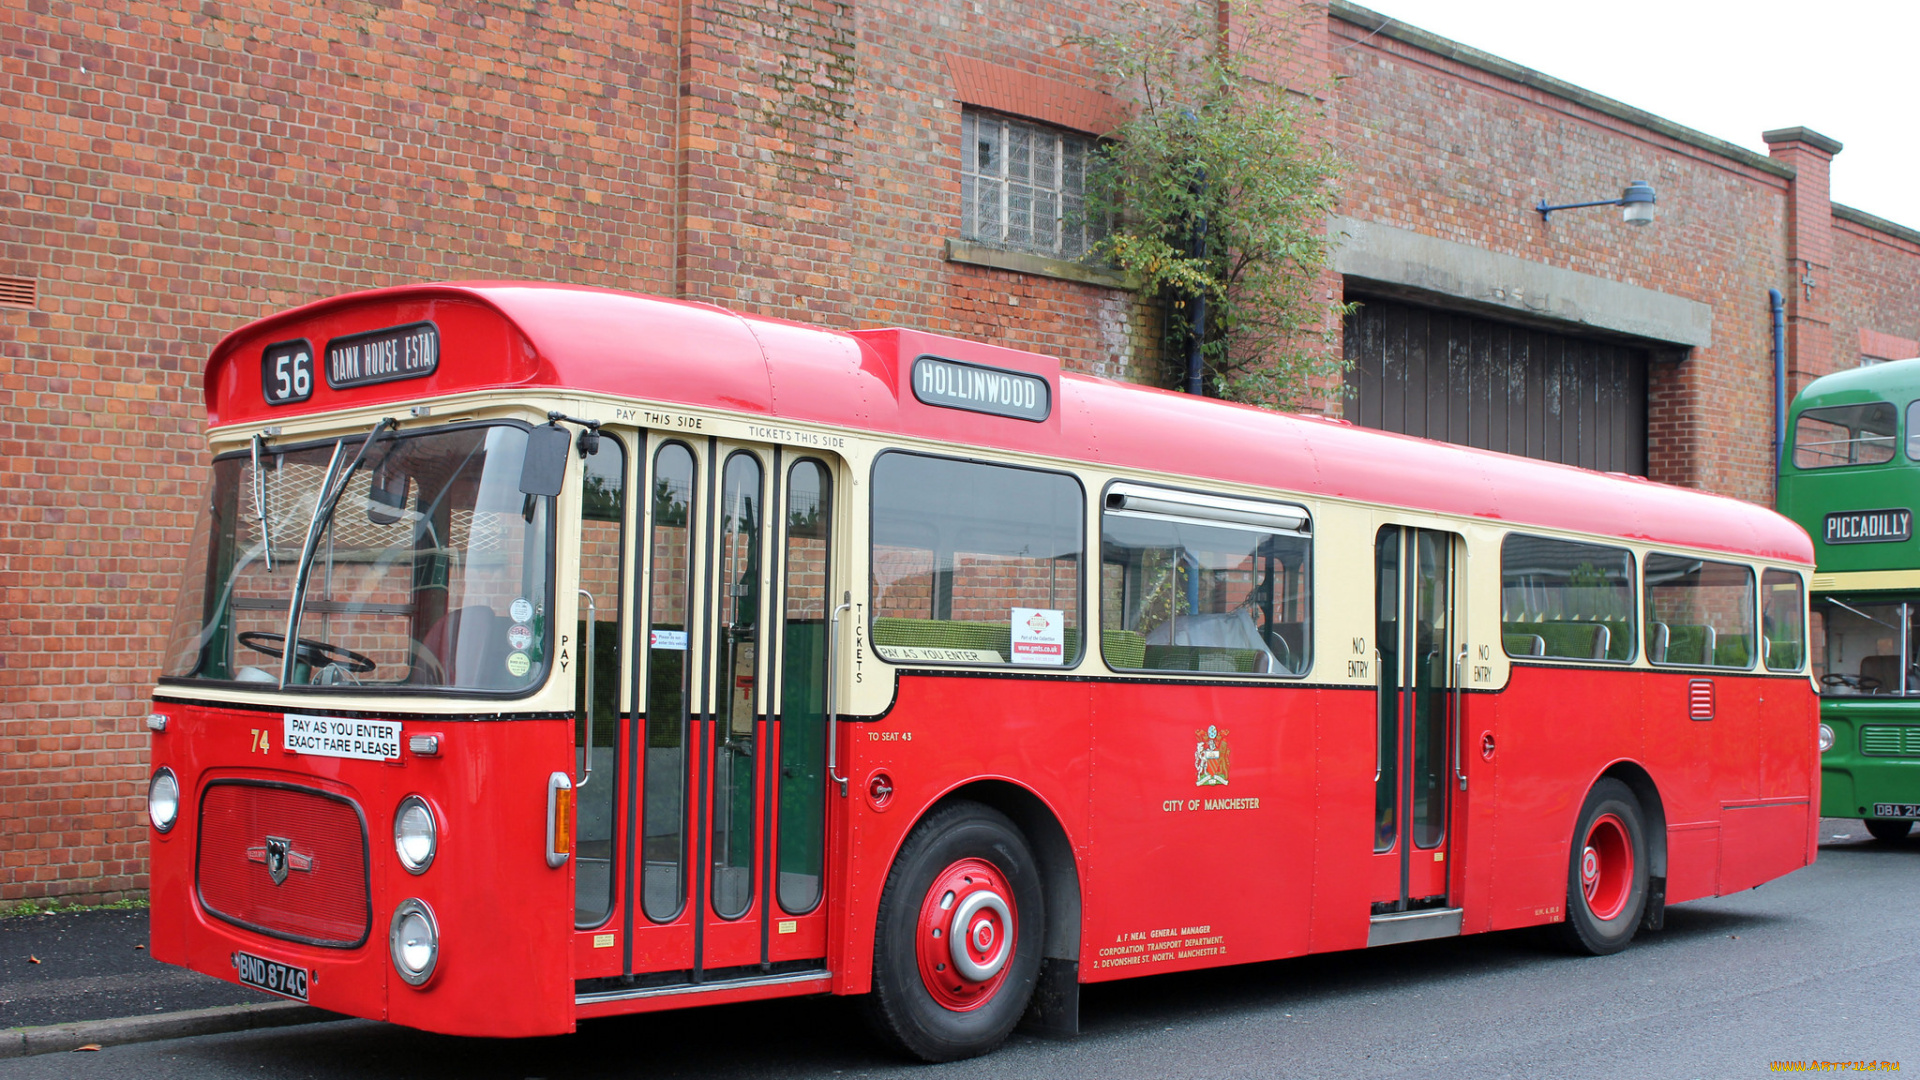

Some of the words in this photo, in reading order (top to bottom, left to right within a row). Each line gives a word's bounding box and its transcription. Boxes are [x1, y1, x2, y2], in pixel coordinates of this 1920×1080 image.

[331, 345, 360, 381] BANK
[364, 339, 399, 376] HOUSE
[405, 331, 436, 370] ESTAT
[275, 352, 310, 399] 56
[921, 362, 1036, 409] HOLLINWOOD
[616, 408, 637, 421] PAY
[644, 412, 671, 426] THIS
[677, 416, 702, 429] SIDE
[749, 426, 792, 441] TICKETS
[794, 431, 818, 445] THIS
[822, 436, 844, 448] SIDE
[1827, 513, 1909, 539] PICCADILLY
[560, 635, 569, 673] PAY
[855, 603, 863, 684] TICKETS
[1352, 637, 1366, 655] NO
[1478, 644, 1490, 661] NO
[880, 648, 900, 658] PAY
[902, 648, 918, 659] AS
[920, 650, 944, 660] YOU
[945, 650, 980, 661] ENTER
[1348, 660, 1369, 679] ENTRY
[1474, 666, 1492, 683] ENTRY
[292, 719, 311, 732] PAY
[313, 721, 327, 734] AS
[330, 722, 353, 737] YOU
[357, 724, 393, 739] ENTER
[868, 732, 880, 741] TO
[882, 732, 900, 741] SEAT
[902, 732, 912, 741] 43
[250, 729, 270, 755] 74
[288, 735, 321, 750] EXACT
[323, 738, 351, 752] FARE
[354, 740, 398, 757] PLEASE
[1162, 800, 1184, 812] CITY
[1188, 800, 1200, 811] OF
[1204, 798, 1260, 811] MANCHESTER
[1876, 804, 1902, 816] DBA
[1130, 932, 1146, 941] NEAL
[1150, 928, 1178, 938] GENERAL
[1181, 925, 1210, 936] MANAGER
[1098, 944, 1144, 956] CORPORATION
[1147, 940, 1182, 952] TRANSPORT
[1102, 956, 1141, 968] DEVONSHIRE
[1178, 946, 1218, 959] MANCHESTER
[240, 954, 266, 984] BND
[268, 964, 306, 996] 874C
